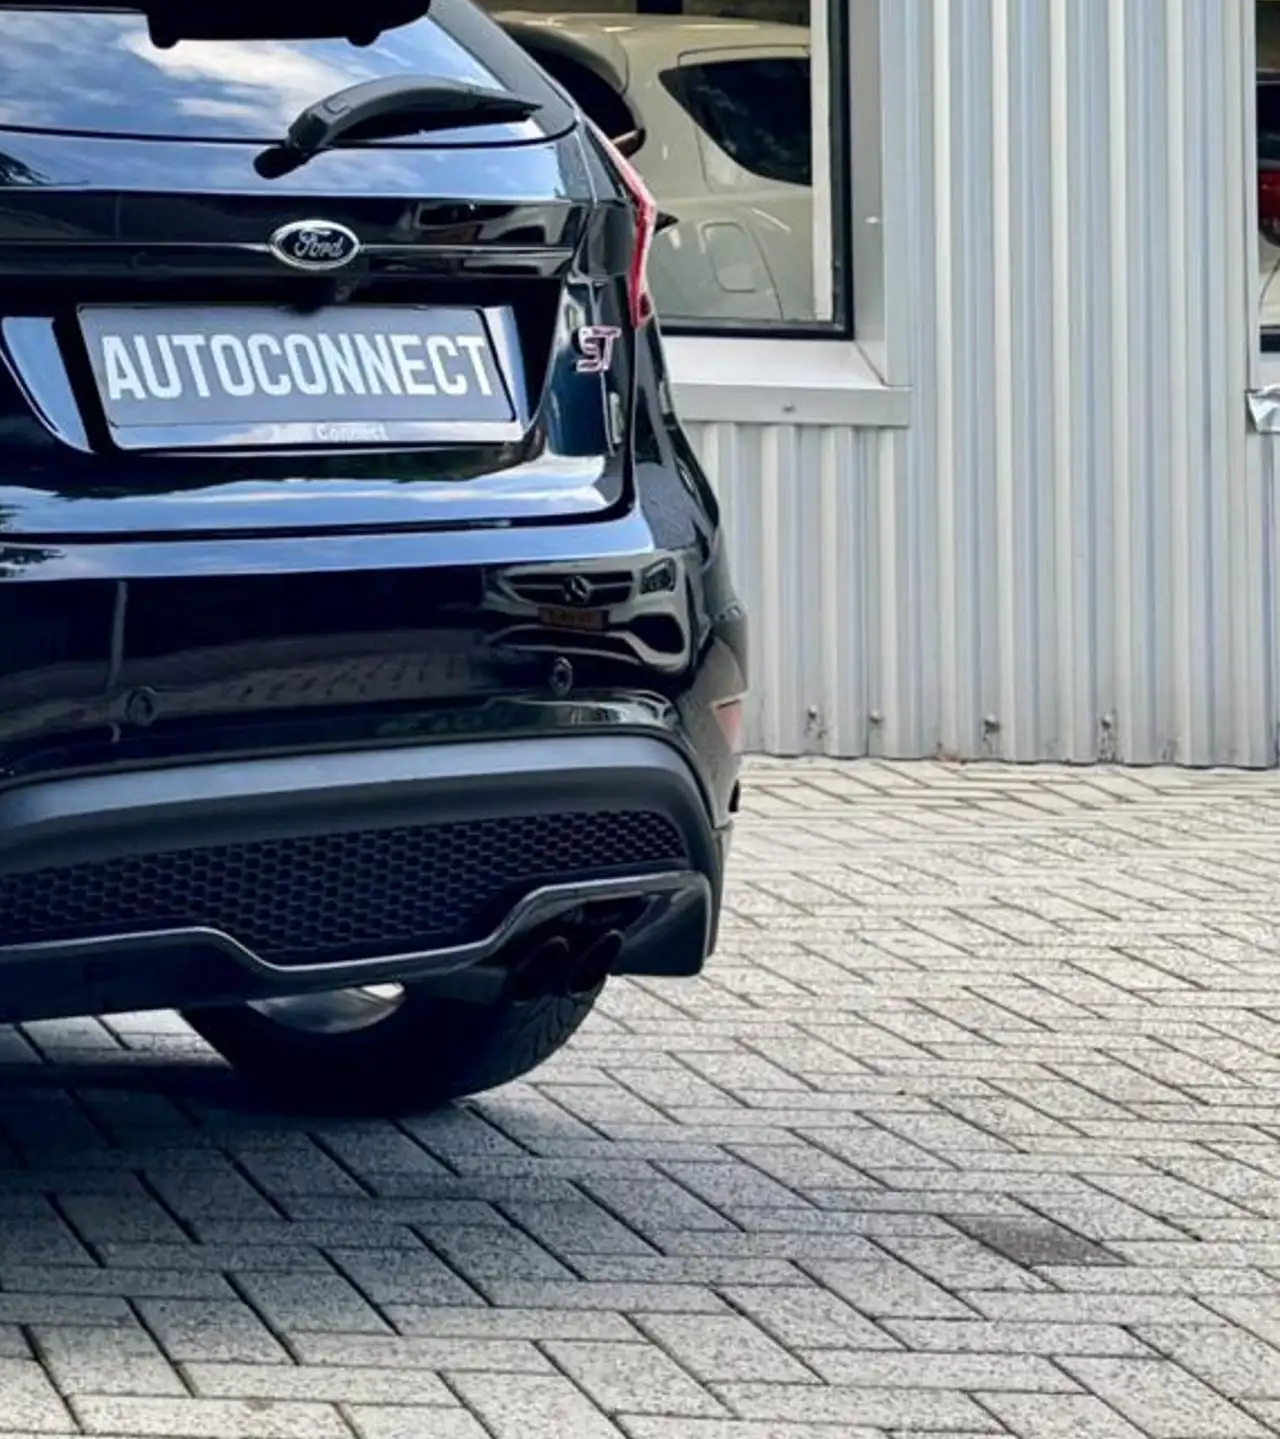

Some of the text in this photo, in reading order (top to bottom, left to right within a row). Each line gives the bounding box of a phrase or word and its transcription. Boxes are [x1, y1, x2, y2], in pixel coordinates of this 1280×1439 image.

[294, 227, 344, 258] Ford
[101, 333, 495, 401] AUTOCONNECT
[576, 325, 622, 372] ST
